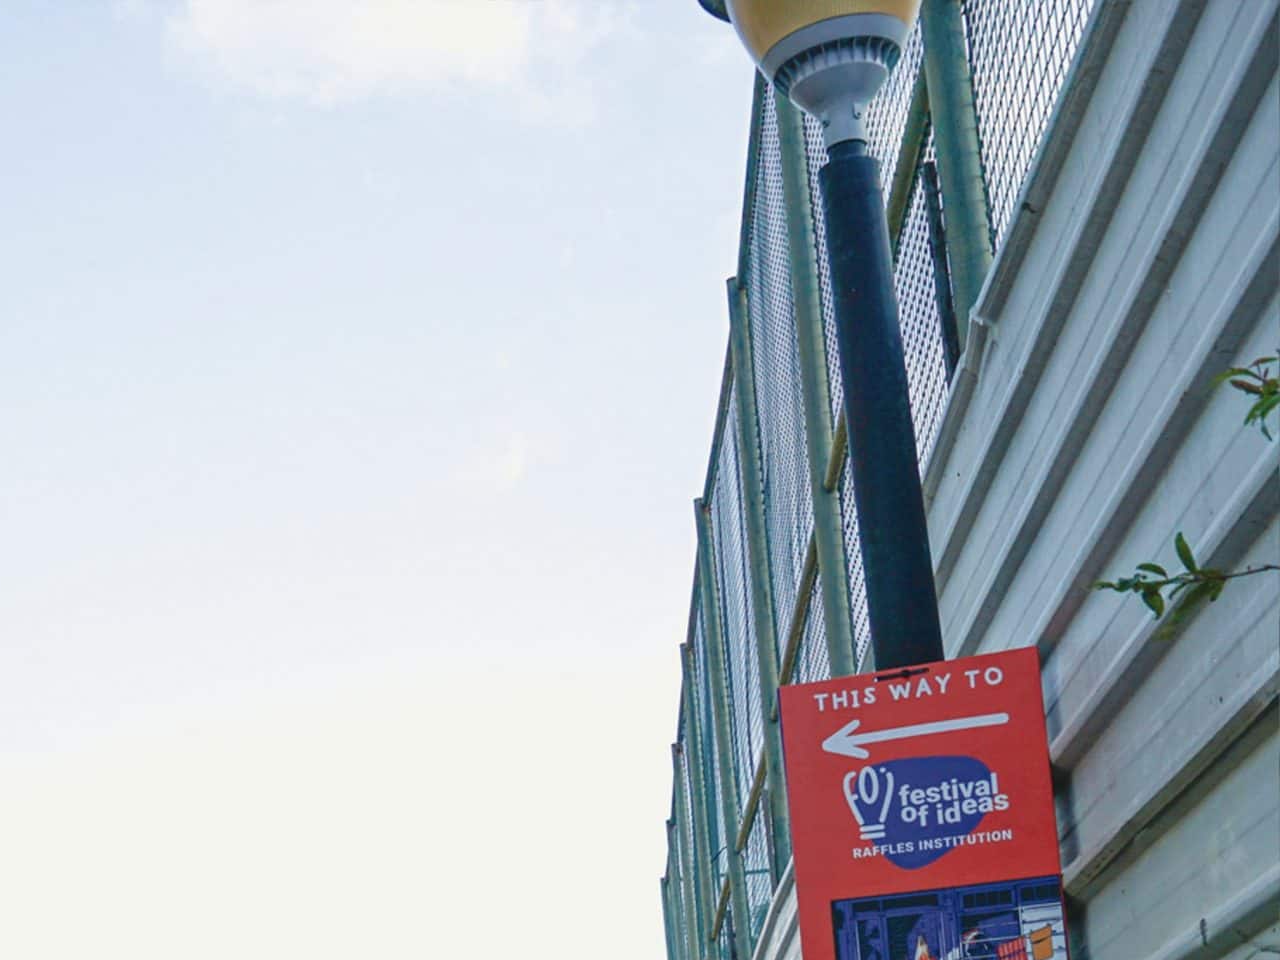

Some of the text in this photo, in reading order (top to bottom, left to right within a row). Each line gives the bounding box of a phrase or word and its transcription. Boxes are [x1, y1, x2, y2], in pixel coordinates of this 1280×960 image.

[814, 667, 1003, 711] THIS WAY TO
[899, 772, 998, 806] festival
[901, 794, 1009, 827] of ideas
[853, 829, 1013, 858] RAFFLES INSTITUTION
